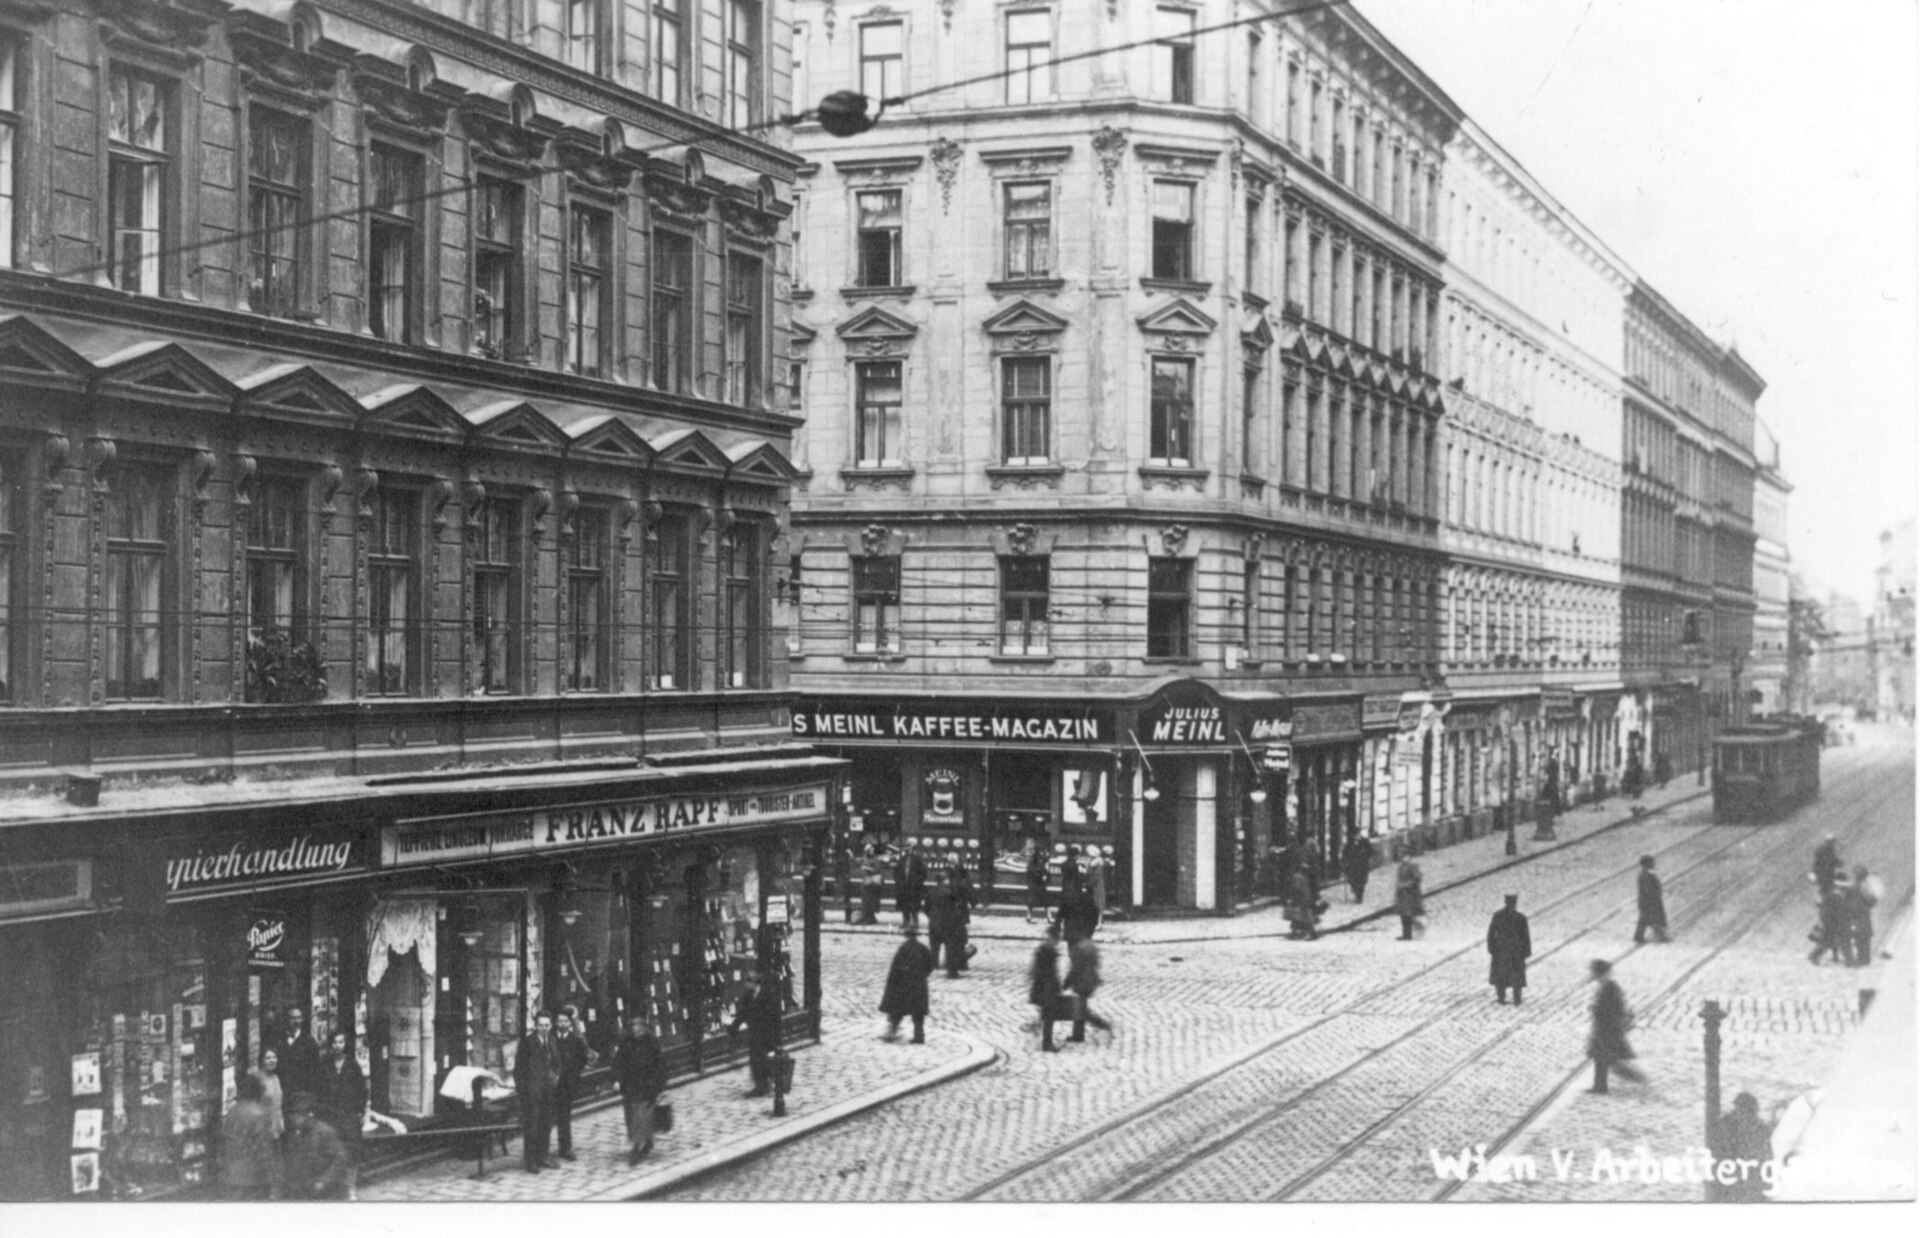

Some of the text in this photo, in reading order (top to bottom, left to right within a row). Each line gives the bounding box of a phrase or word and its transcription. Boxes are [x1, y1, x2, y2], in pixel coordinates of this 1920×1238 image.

[1165, 707, 1219, 722] JULIUS
[815, 714, 884, 740] MEINL
[893, 715, 1099, 740] KAFFEE-MAGAZIN
[1153, 721, 1226, 741] MEINL
[925, 768, 959, 786] MEINL
[545, 805, 646, 843] FRANZ
[654, 799, 721, 830] RAPF
[247, 919, 284, 951] Papier
